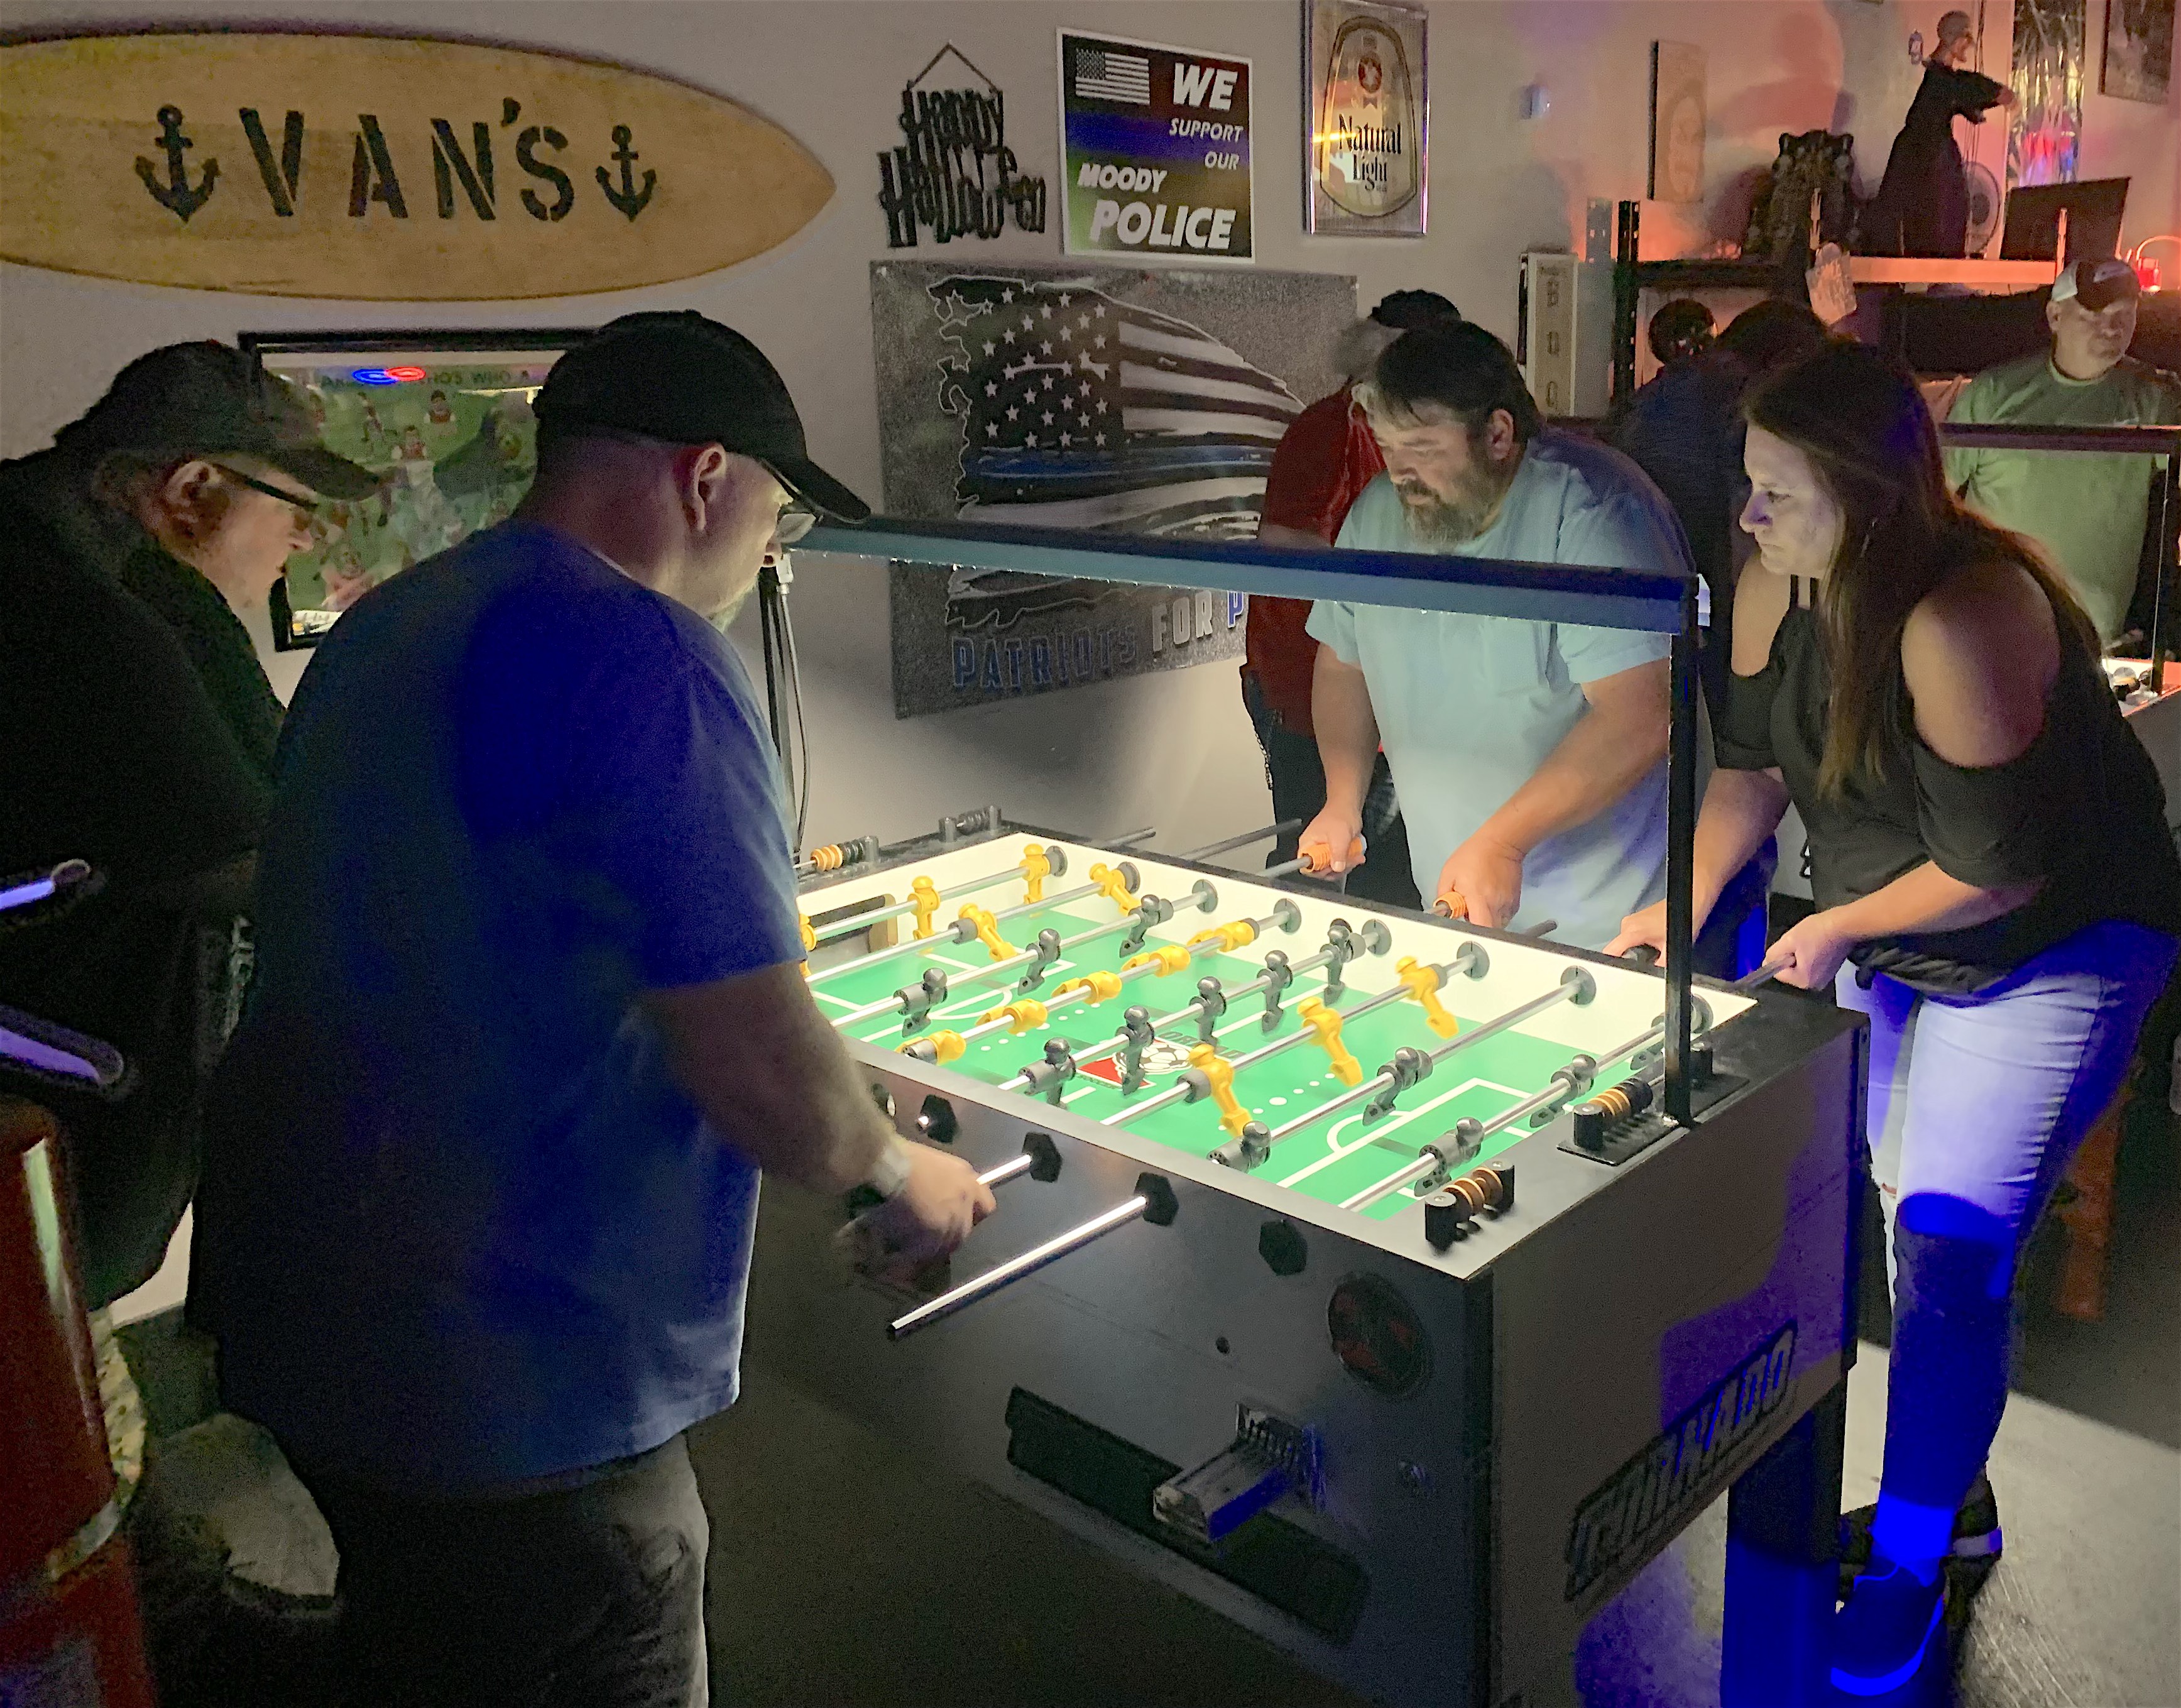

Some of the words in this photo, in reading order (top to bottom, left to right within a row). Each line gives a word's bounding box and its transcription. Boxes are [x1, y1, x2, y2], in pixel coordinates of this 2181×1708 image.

[1173, 63, 1238, 111] WE
[1169, 118, 1244, 143] SUPPORT
[1338, 114, 1402, 155] Natural
[238, 97, 574, 222] VAN'S
[1078, 162, 1168, 194] MOODY
[1204, 151, 1240, 170] OUR
[1353, 153, 1387, 191] Light
[1090, 199, 1237, 249] POLICE
[951, 627, 1136, 689] PATRIOTS
[1152, 591, 1213, 652] FOR
